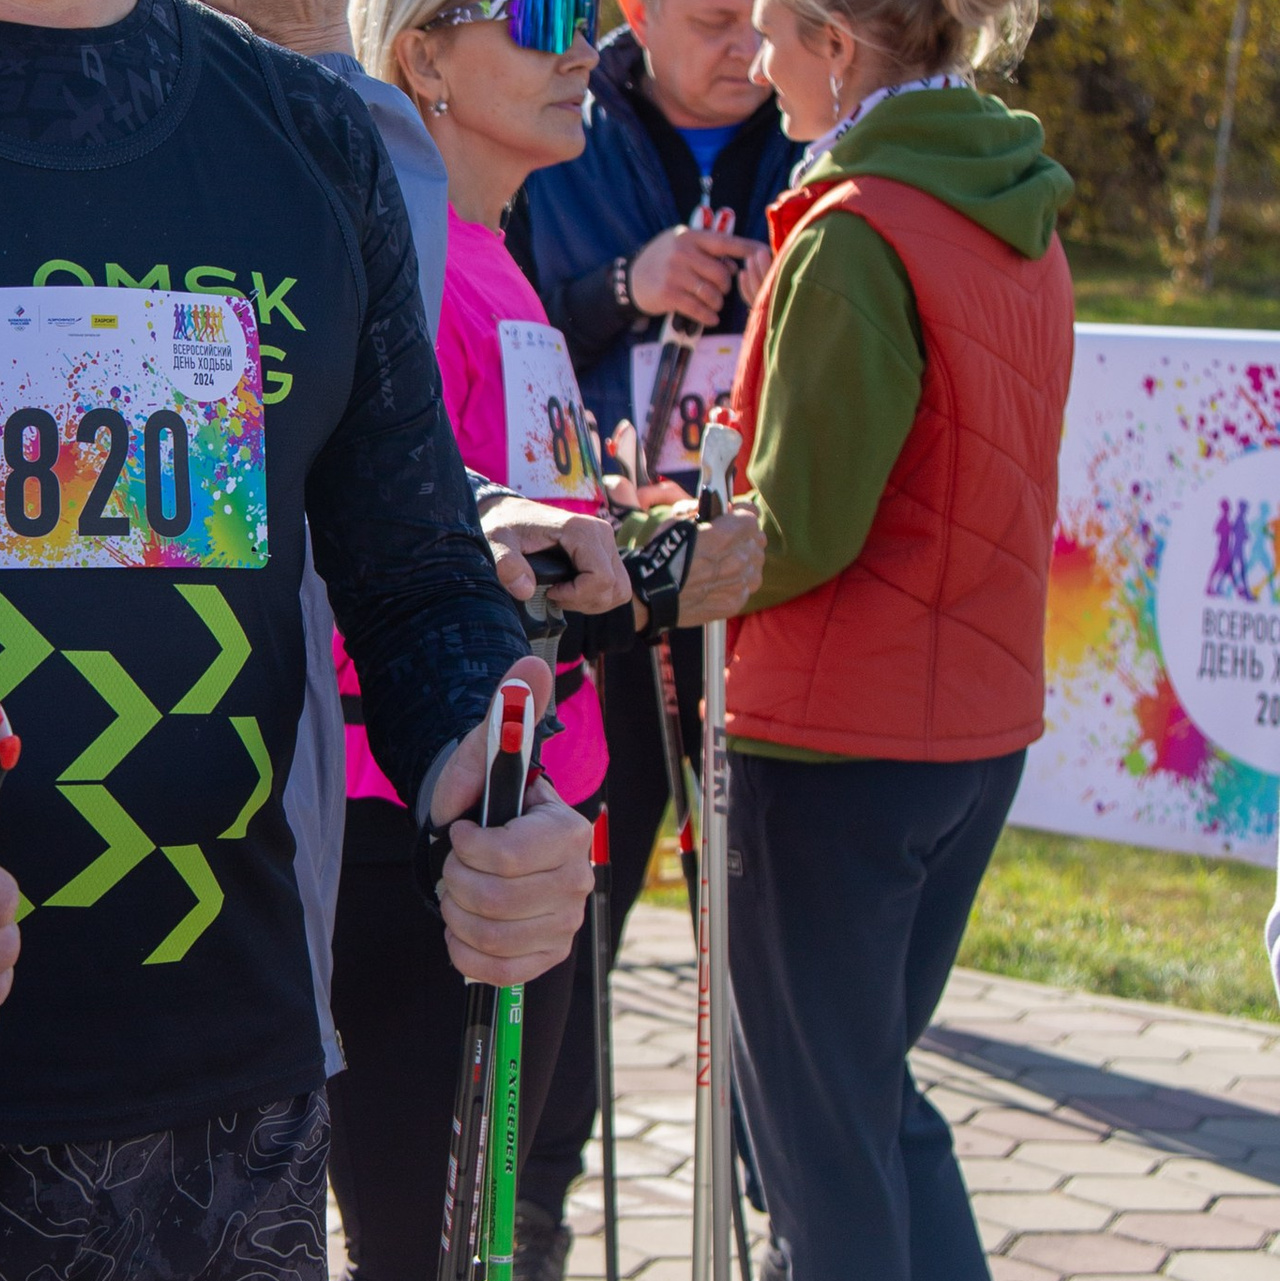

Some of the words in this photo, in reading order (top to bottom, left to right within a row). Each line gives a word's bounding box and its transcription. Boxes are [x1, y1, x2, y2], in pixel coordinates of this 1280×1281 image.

[173, 343, 232, 358] ВСЕРОССИЙСКИЙ
[173, 356, 195, 371] ДЕНЬ
[198, 358, 233, 372] ХОДЬБЫ
[193, 372, 214, 386] 2024
[4, 408, 193, 538] 820
[640, 528, 683, 579] LEKI
[1196, 641, 1264, 682] ДЕНЬ
